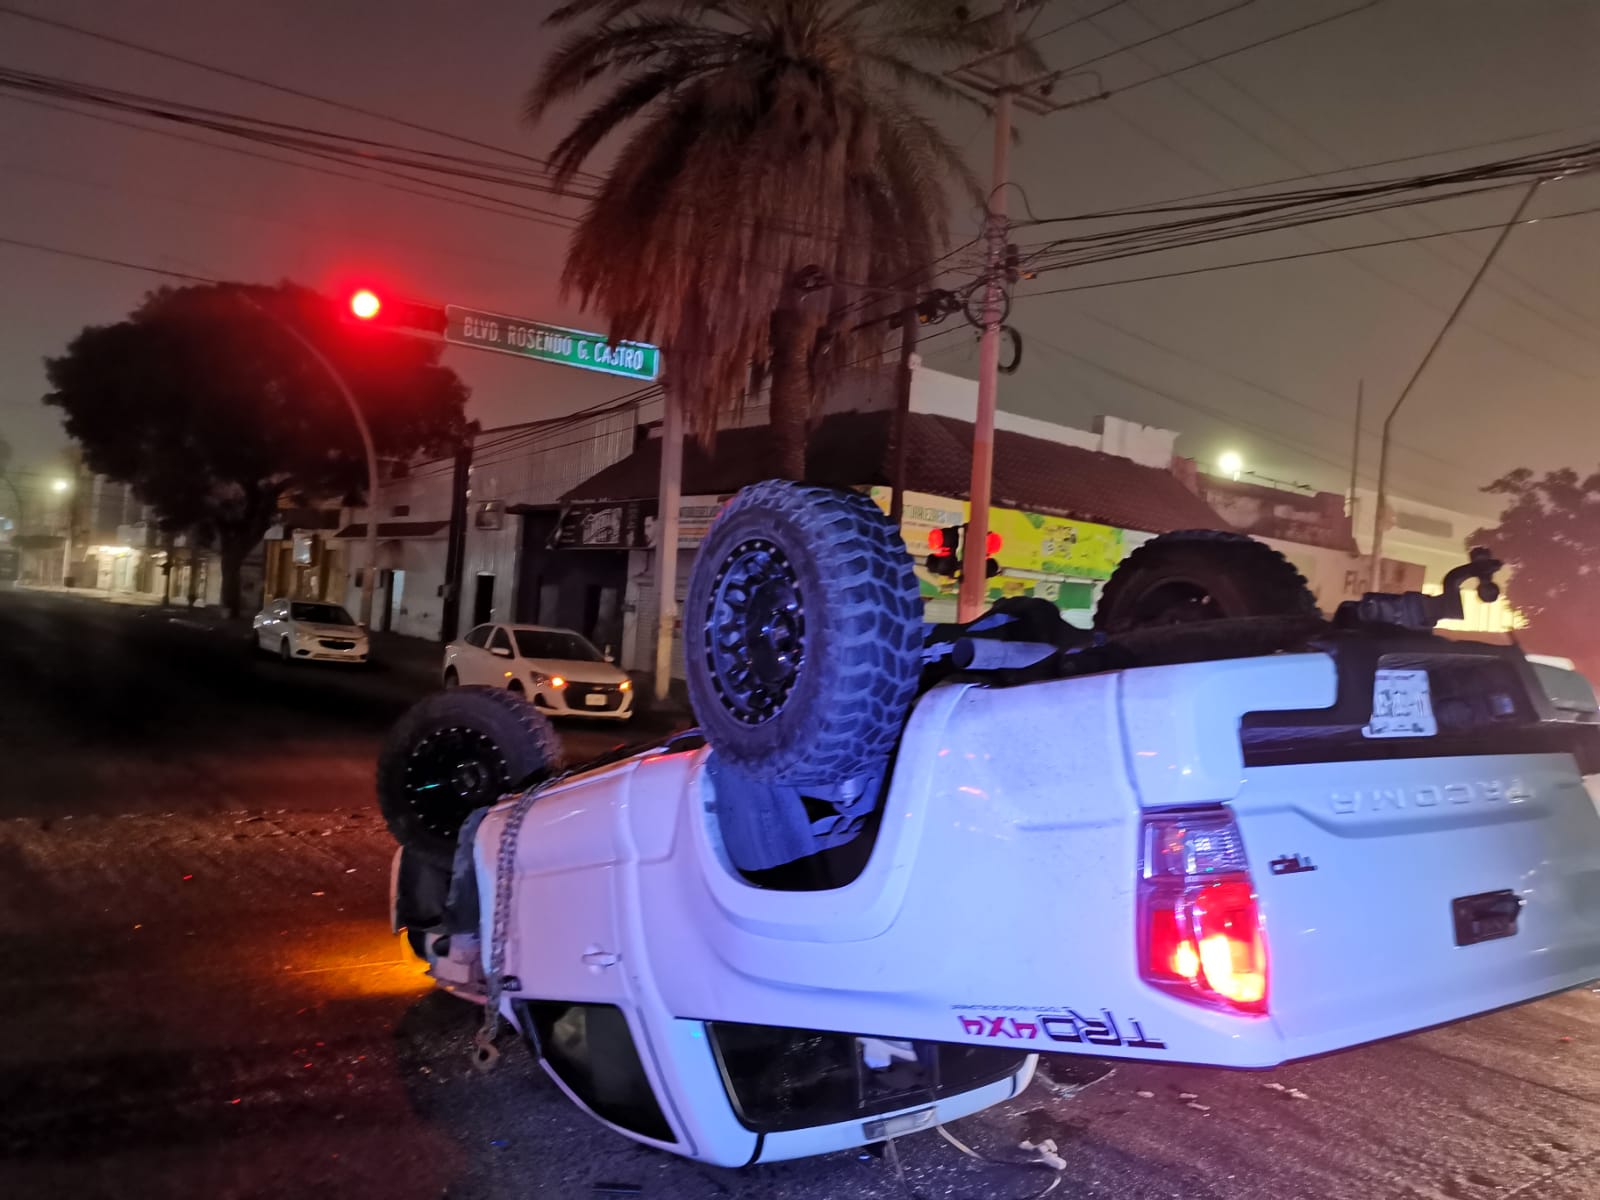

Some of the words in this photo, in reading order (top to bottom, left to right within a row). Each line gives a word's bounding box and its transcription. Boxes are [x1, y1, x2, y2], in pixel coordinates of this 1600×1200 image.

[463, 316, 500, 342] BLVD.
[507, 325, 572, 356] ROSENDO
[577, 340, 589, 360] G.
[594, 342, 644, 370] CASTRO
[1331, 779, 1534, 814] TACOMA
[1038, 1006, 1167, 1049] TRD
